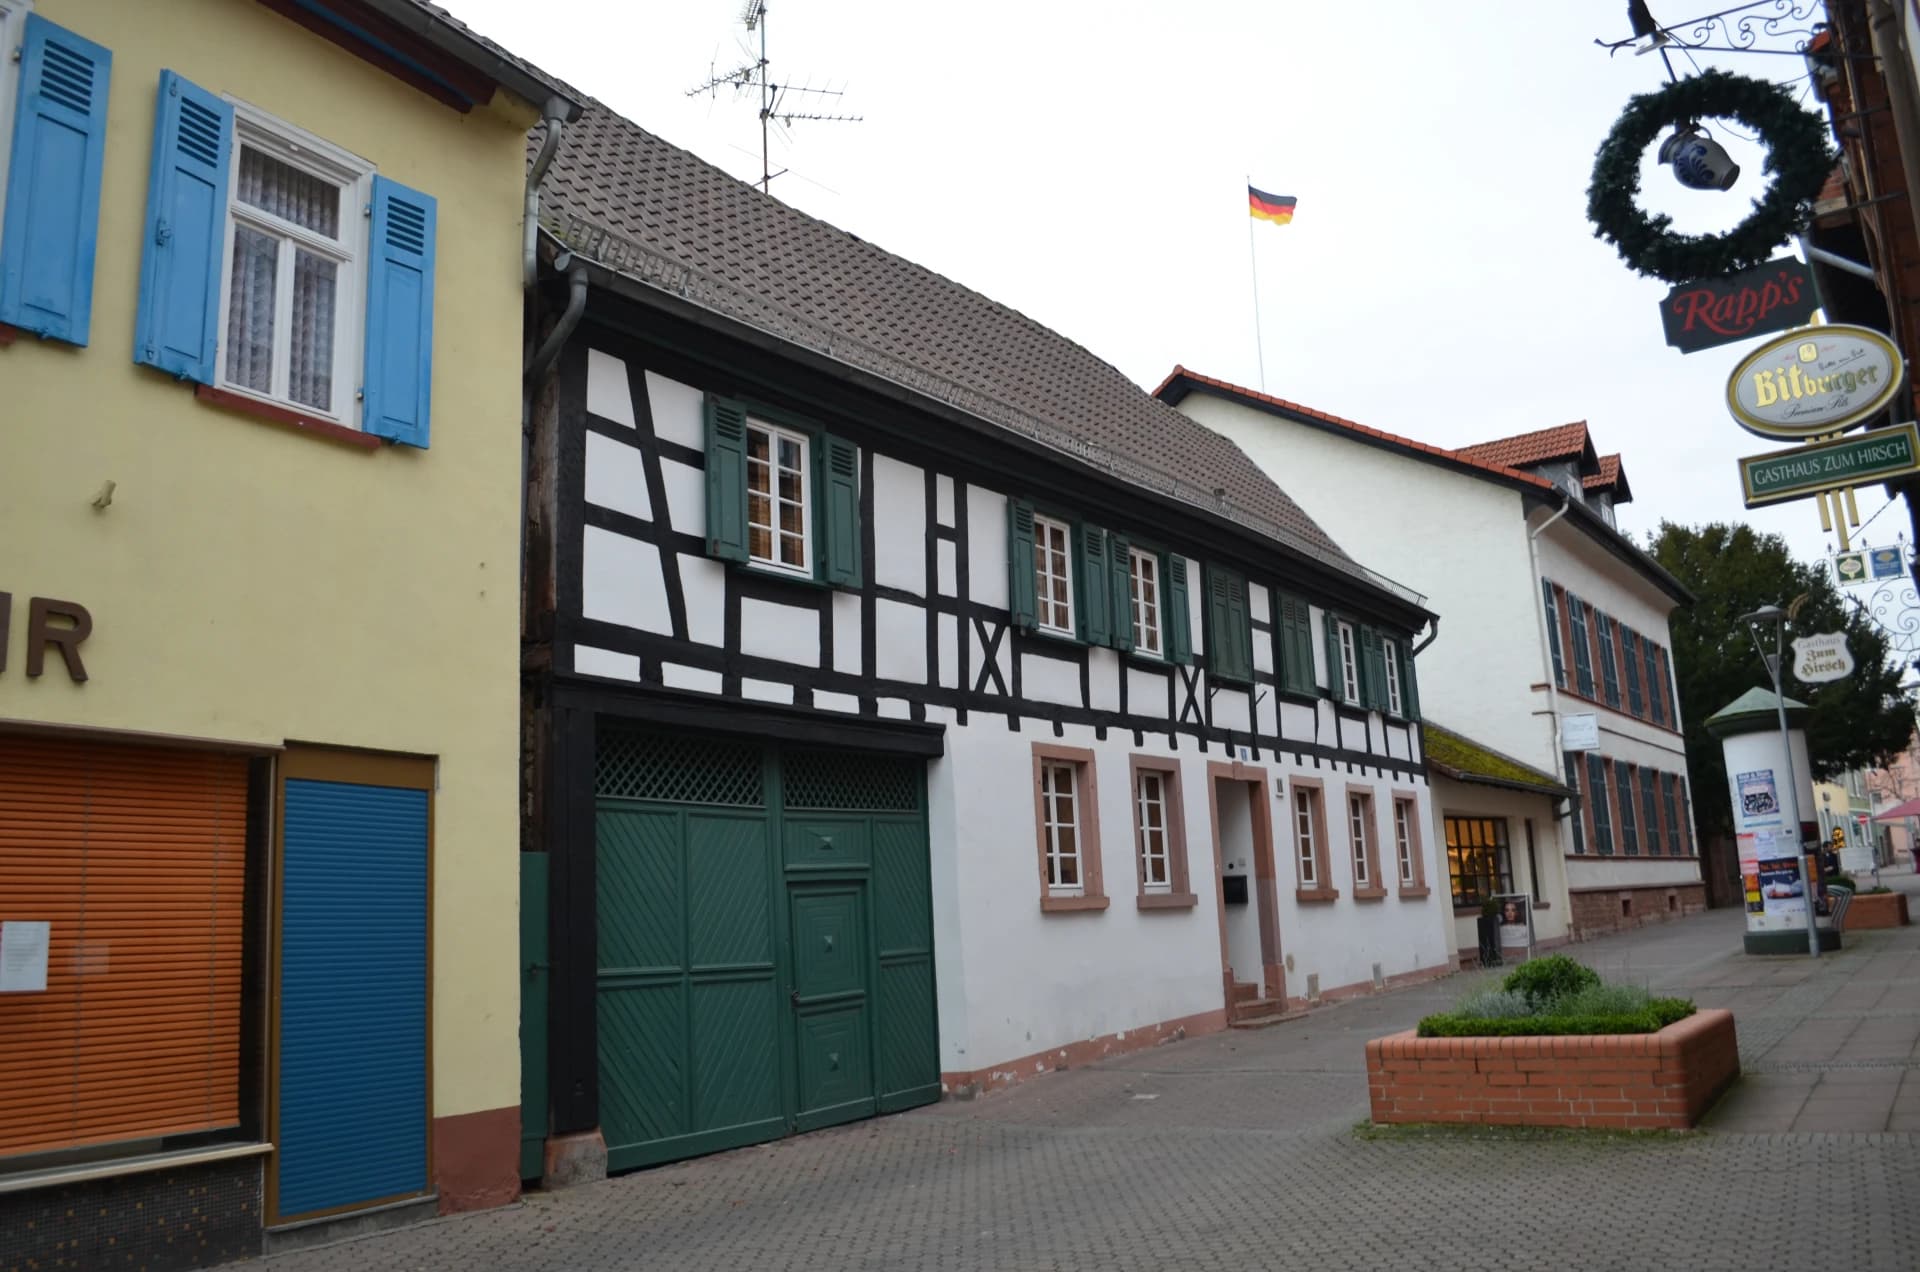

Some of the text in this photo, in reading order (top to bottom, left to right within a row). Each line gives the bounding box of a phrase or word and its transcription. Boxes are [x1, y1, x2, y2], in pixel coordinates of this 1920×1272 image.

[1672, 271, 1804, 335] Rapp's
[1753, 363, 1878, 407] Bitburger
[1754, 441, 1908, 485] GASTHAUS ZUM HIRSCH
